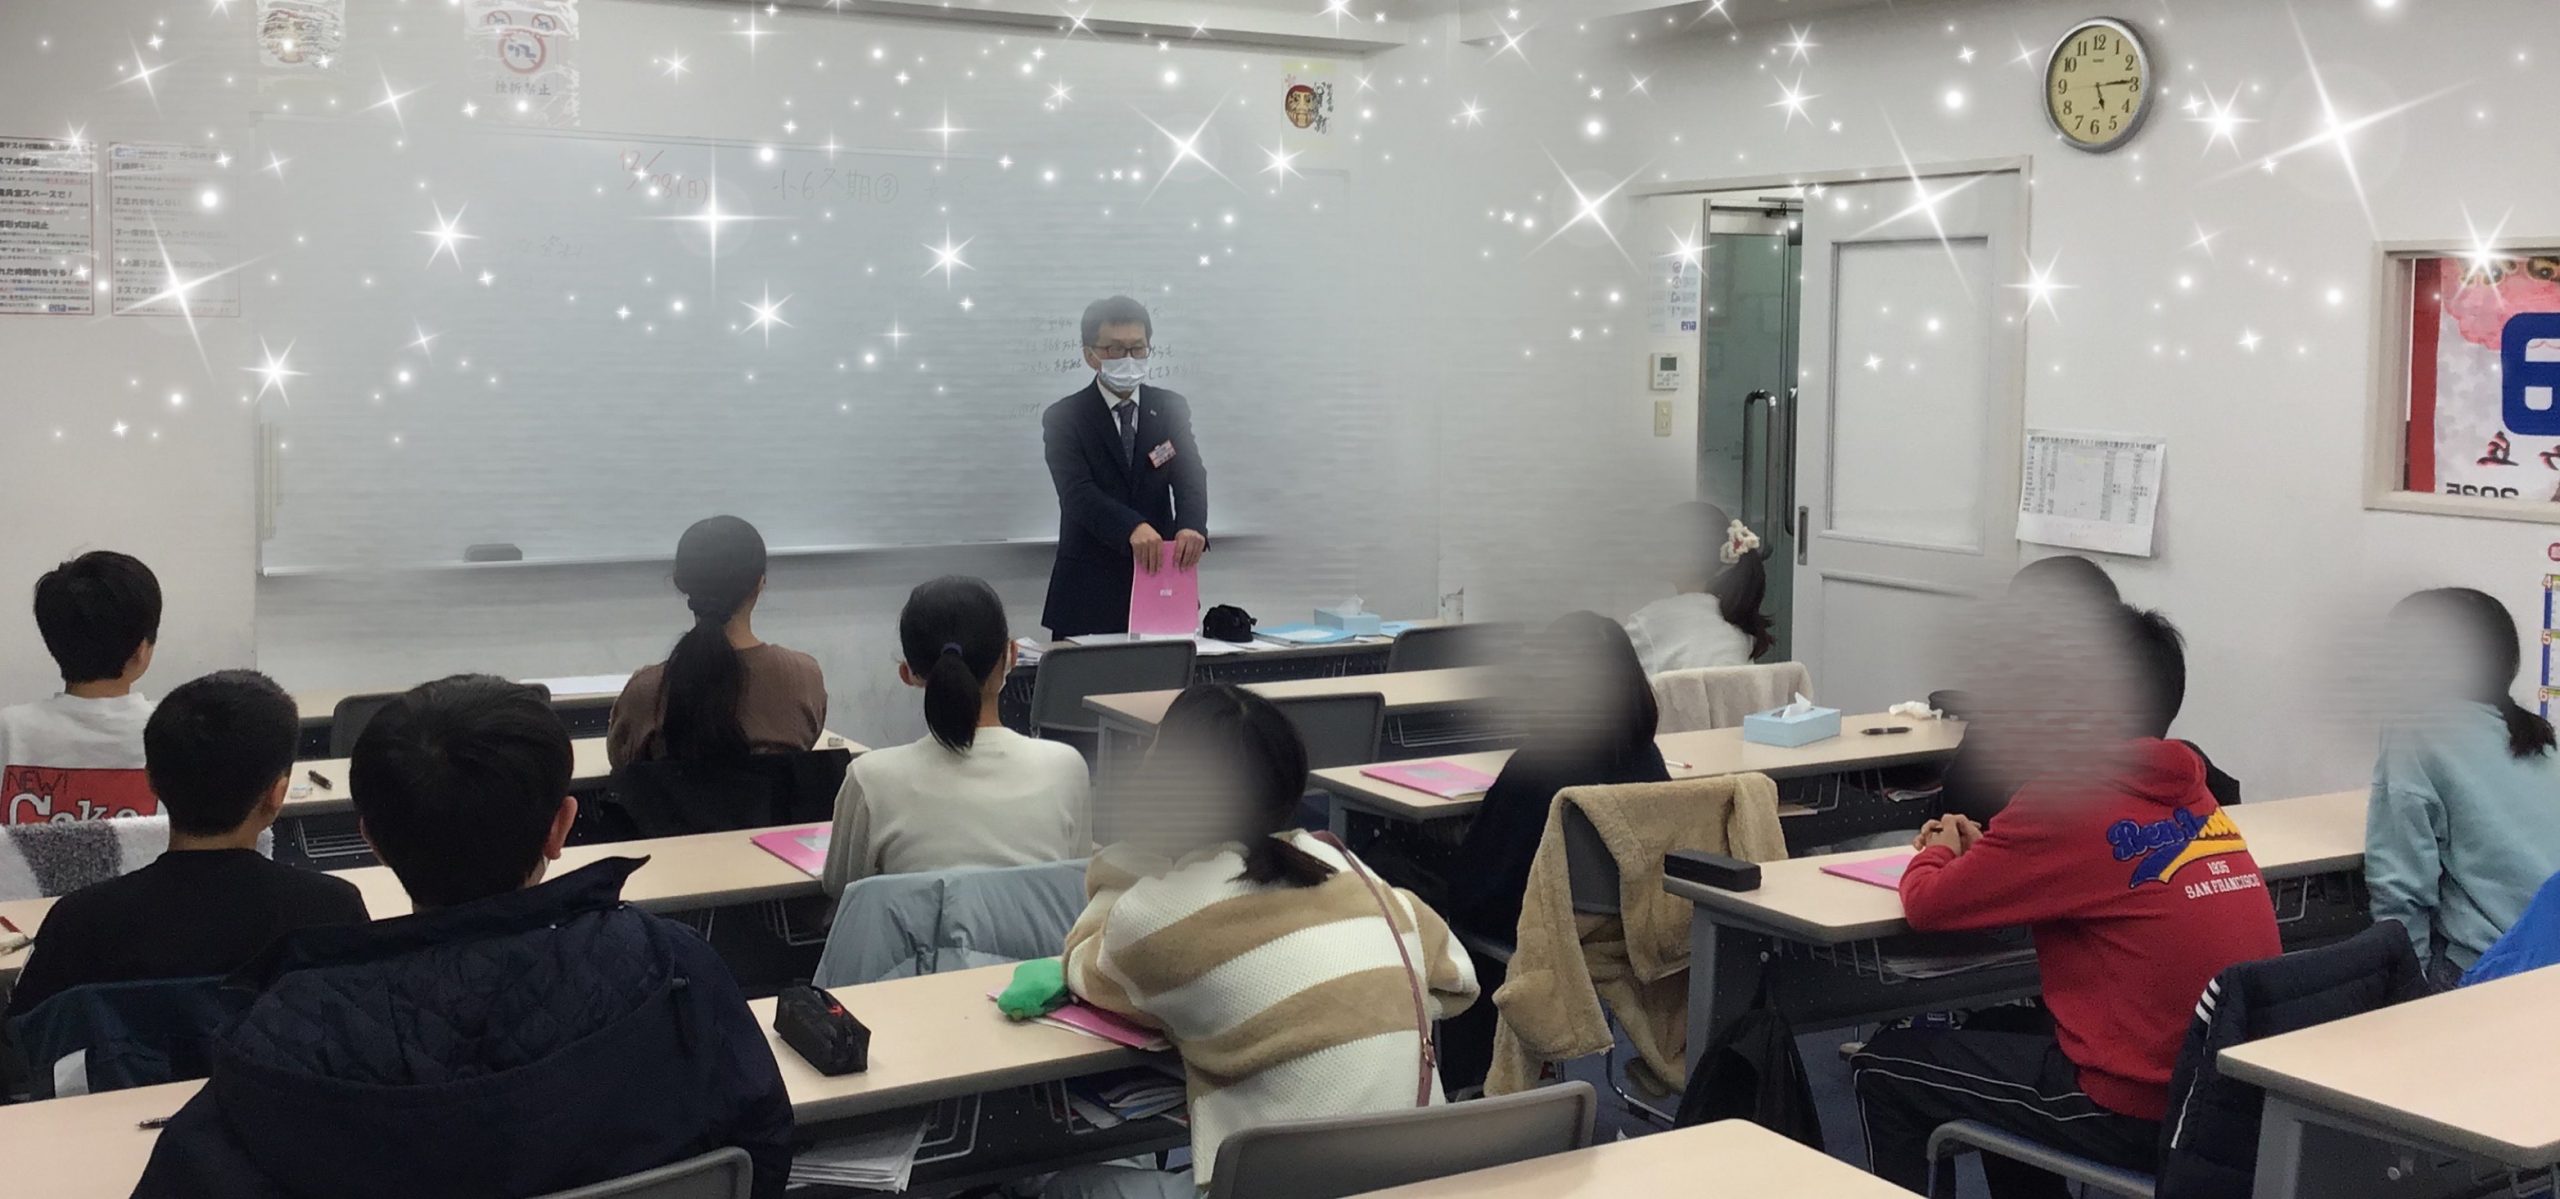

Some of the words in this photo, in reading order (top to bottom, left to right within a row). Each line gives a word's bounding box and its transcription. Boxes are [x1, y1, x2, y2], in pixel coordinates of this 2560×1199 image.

[2077, 41, 2088, 56] 11
[2093, 34, 2107, 51] 12
[2115, 39, 2121, 55] 1
[2063, 57, 2077, 73] 10
[2125, 54, 2134, 71] 2
[2058, 79, 2067, 95] 9
[2129, 77, 2139, 93] 3
[2063, 100, 2072, 115] 8
[2121, 98, 2130, 114] 4
[2075, 115, 2084, 130] 7
[2090, 119, 2100, 135] 6
[2108, 116, 2117, 131] 5
[1681, 320, 1697, 331] ena
[2543, 575, 2552, 589] 4
[2541, 629, 2551, 645] 5
[2538, 687, 2548, 702] 6
[6, 769, 69, 794] NEW!
[2184, 880, 2214, 900] SAN
[2210, 873, 2261, 894] FRANCISCO
